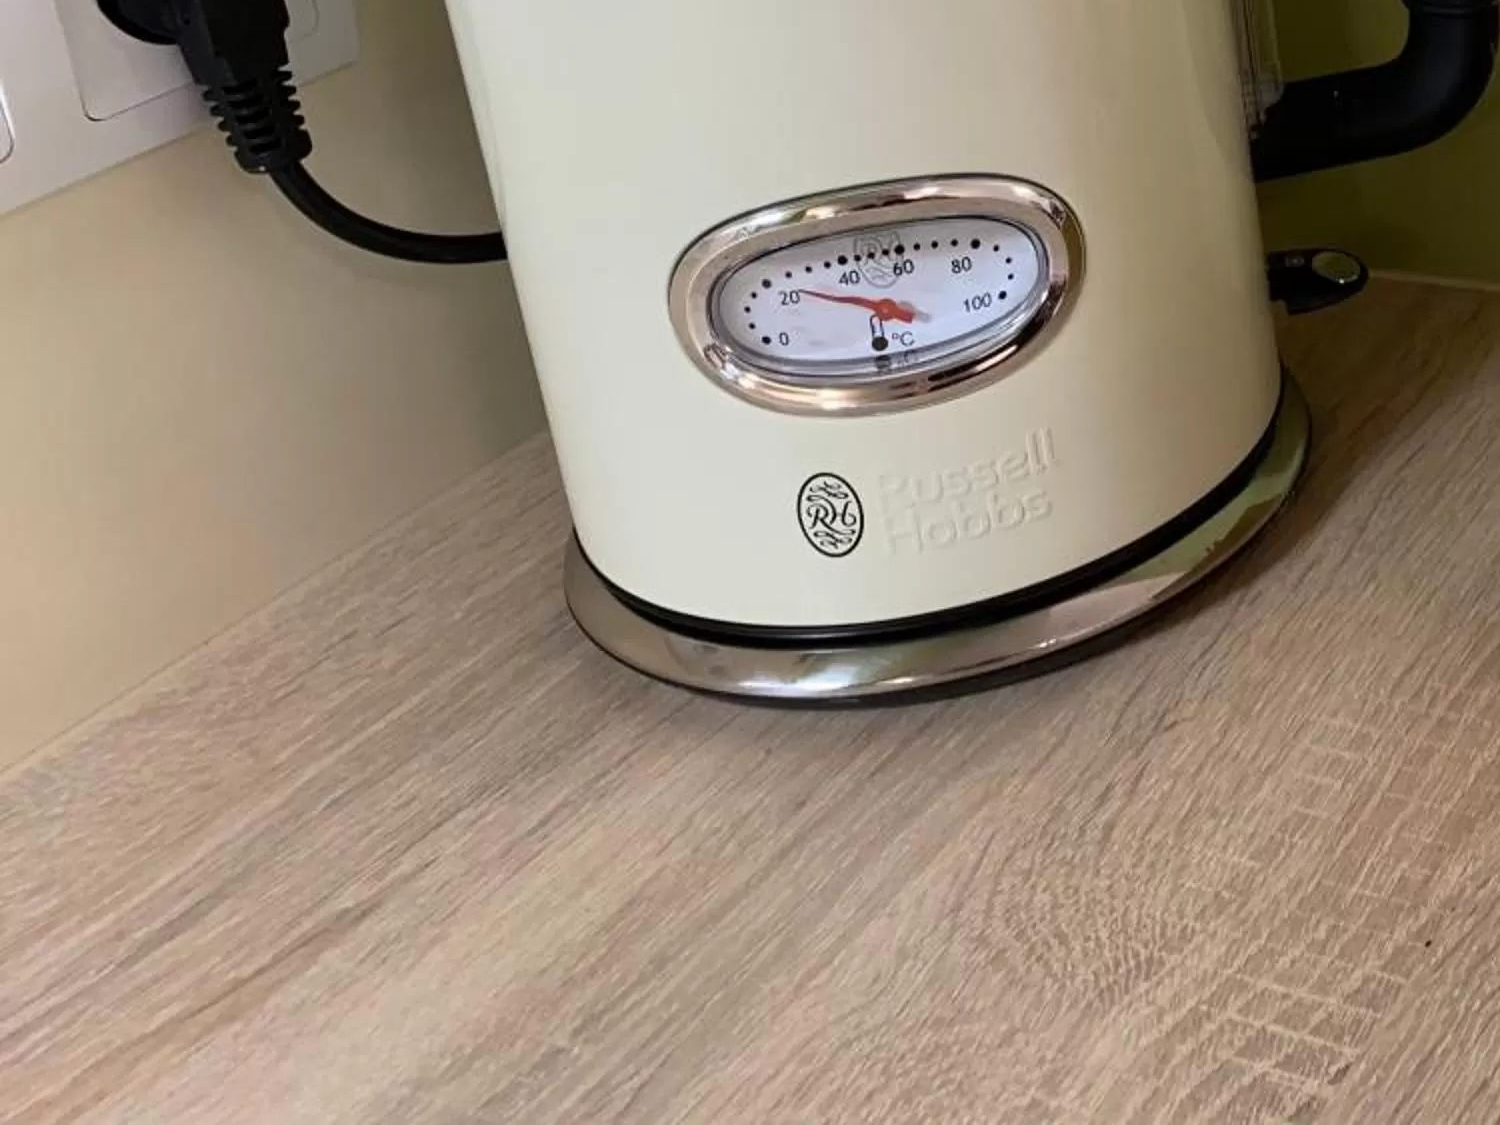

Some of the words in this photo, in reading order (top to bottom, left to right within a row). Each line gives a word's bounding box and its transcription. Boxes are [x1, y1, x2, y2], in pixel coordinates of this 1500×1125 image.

[779, 290, 801, 306] 20
[838, 270, 861, 286] 40
[893, 258, 915, 276] 60
[951, 256, 973, 274] 80
[778, 332, 790, 346] 0
[963, 292, 993, 313] 100
[879, 427, 1055, 513] Russell
[884, 488, 1053, 556] Hobbs
